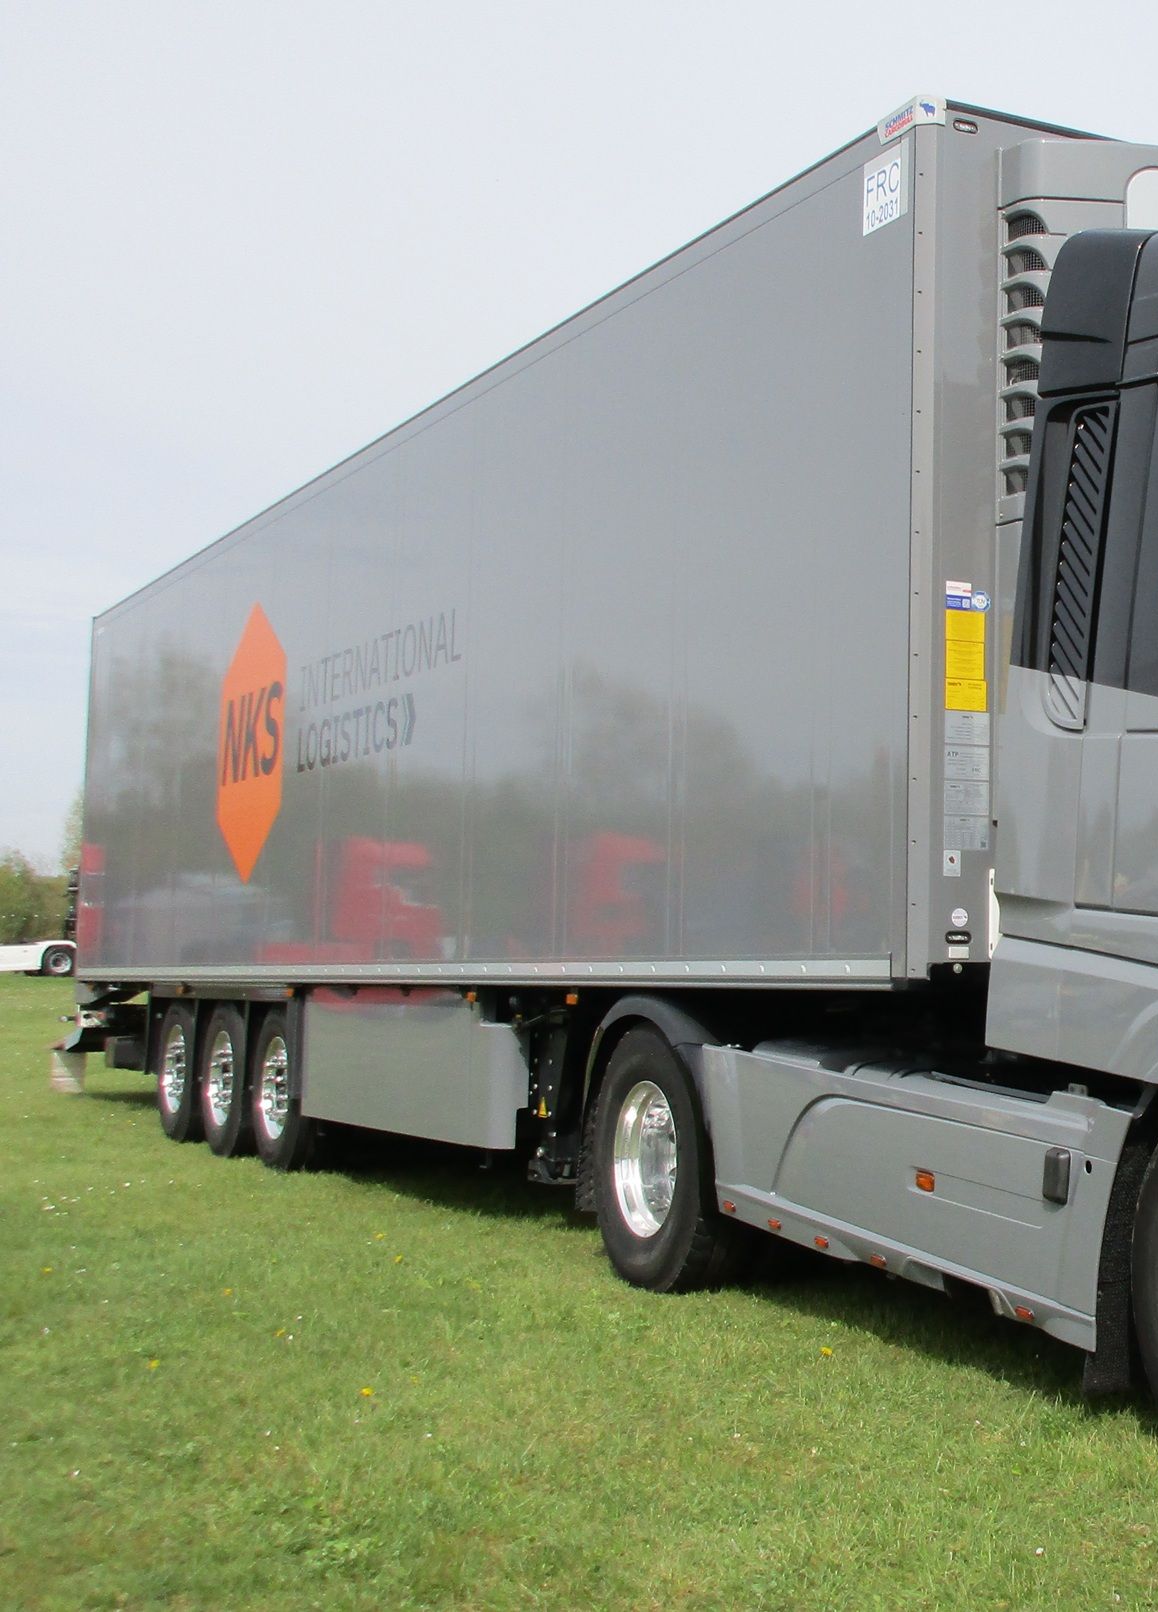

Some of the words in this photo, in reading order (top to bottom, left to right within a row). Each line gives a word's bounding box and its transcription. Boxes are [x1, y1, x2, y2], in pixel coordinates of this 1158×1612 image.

[866, 162, 899, 207] FRC
[866, 197, 899, 230] 10-2031
[300, 608, 461, 712] INTERNATIONAL
[222, 681, 283, 786] NKS
[297, 697, 399, 773] LOGISTICS
